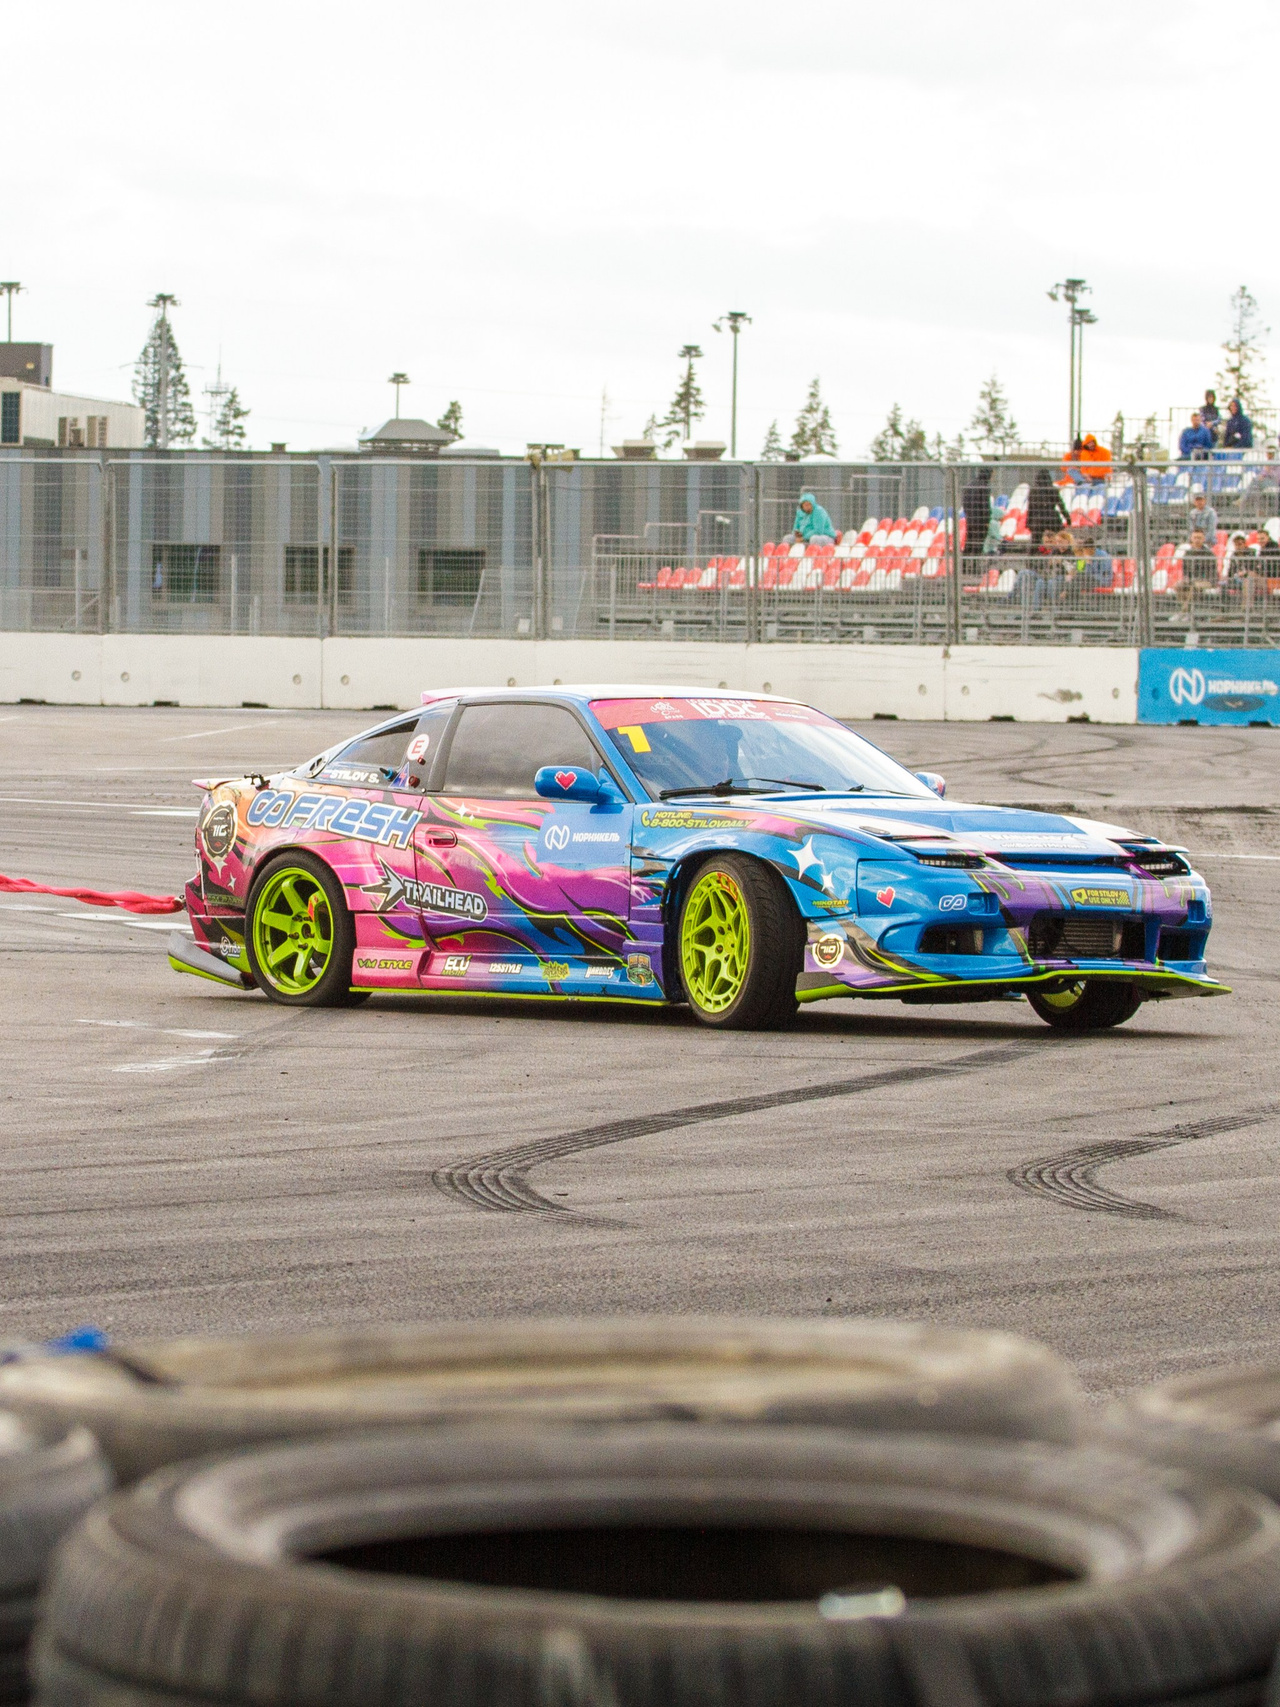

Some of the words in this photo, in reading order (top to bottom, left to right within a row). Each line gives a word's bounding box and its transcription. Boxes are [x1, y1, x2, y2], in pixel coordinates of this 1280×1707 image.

[617, 725, 651, 752] 1
[411, 740, 425, 754] E
[330, 769, 369, 782] STILOV
[368, 773, 380, 784] S.
[650, 819, 753, 828] 8-800-STILOVDAILY
[572, 832, 621, 843] НОРНИКЕЛЬ
[404, 881, 484, 915] TRAILHEAD
[357, 958, 377, 968] VM
[379, 959, 413, 969] STYLE
